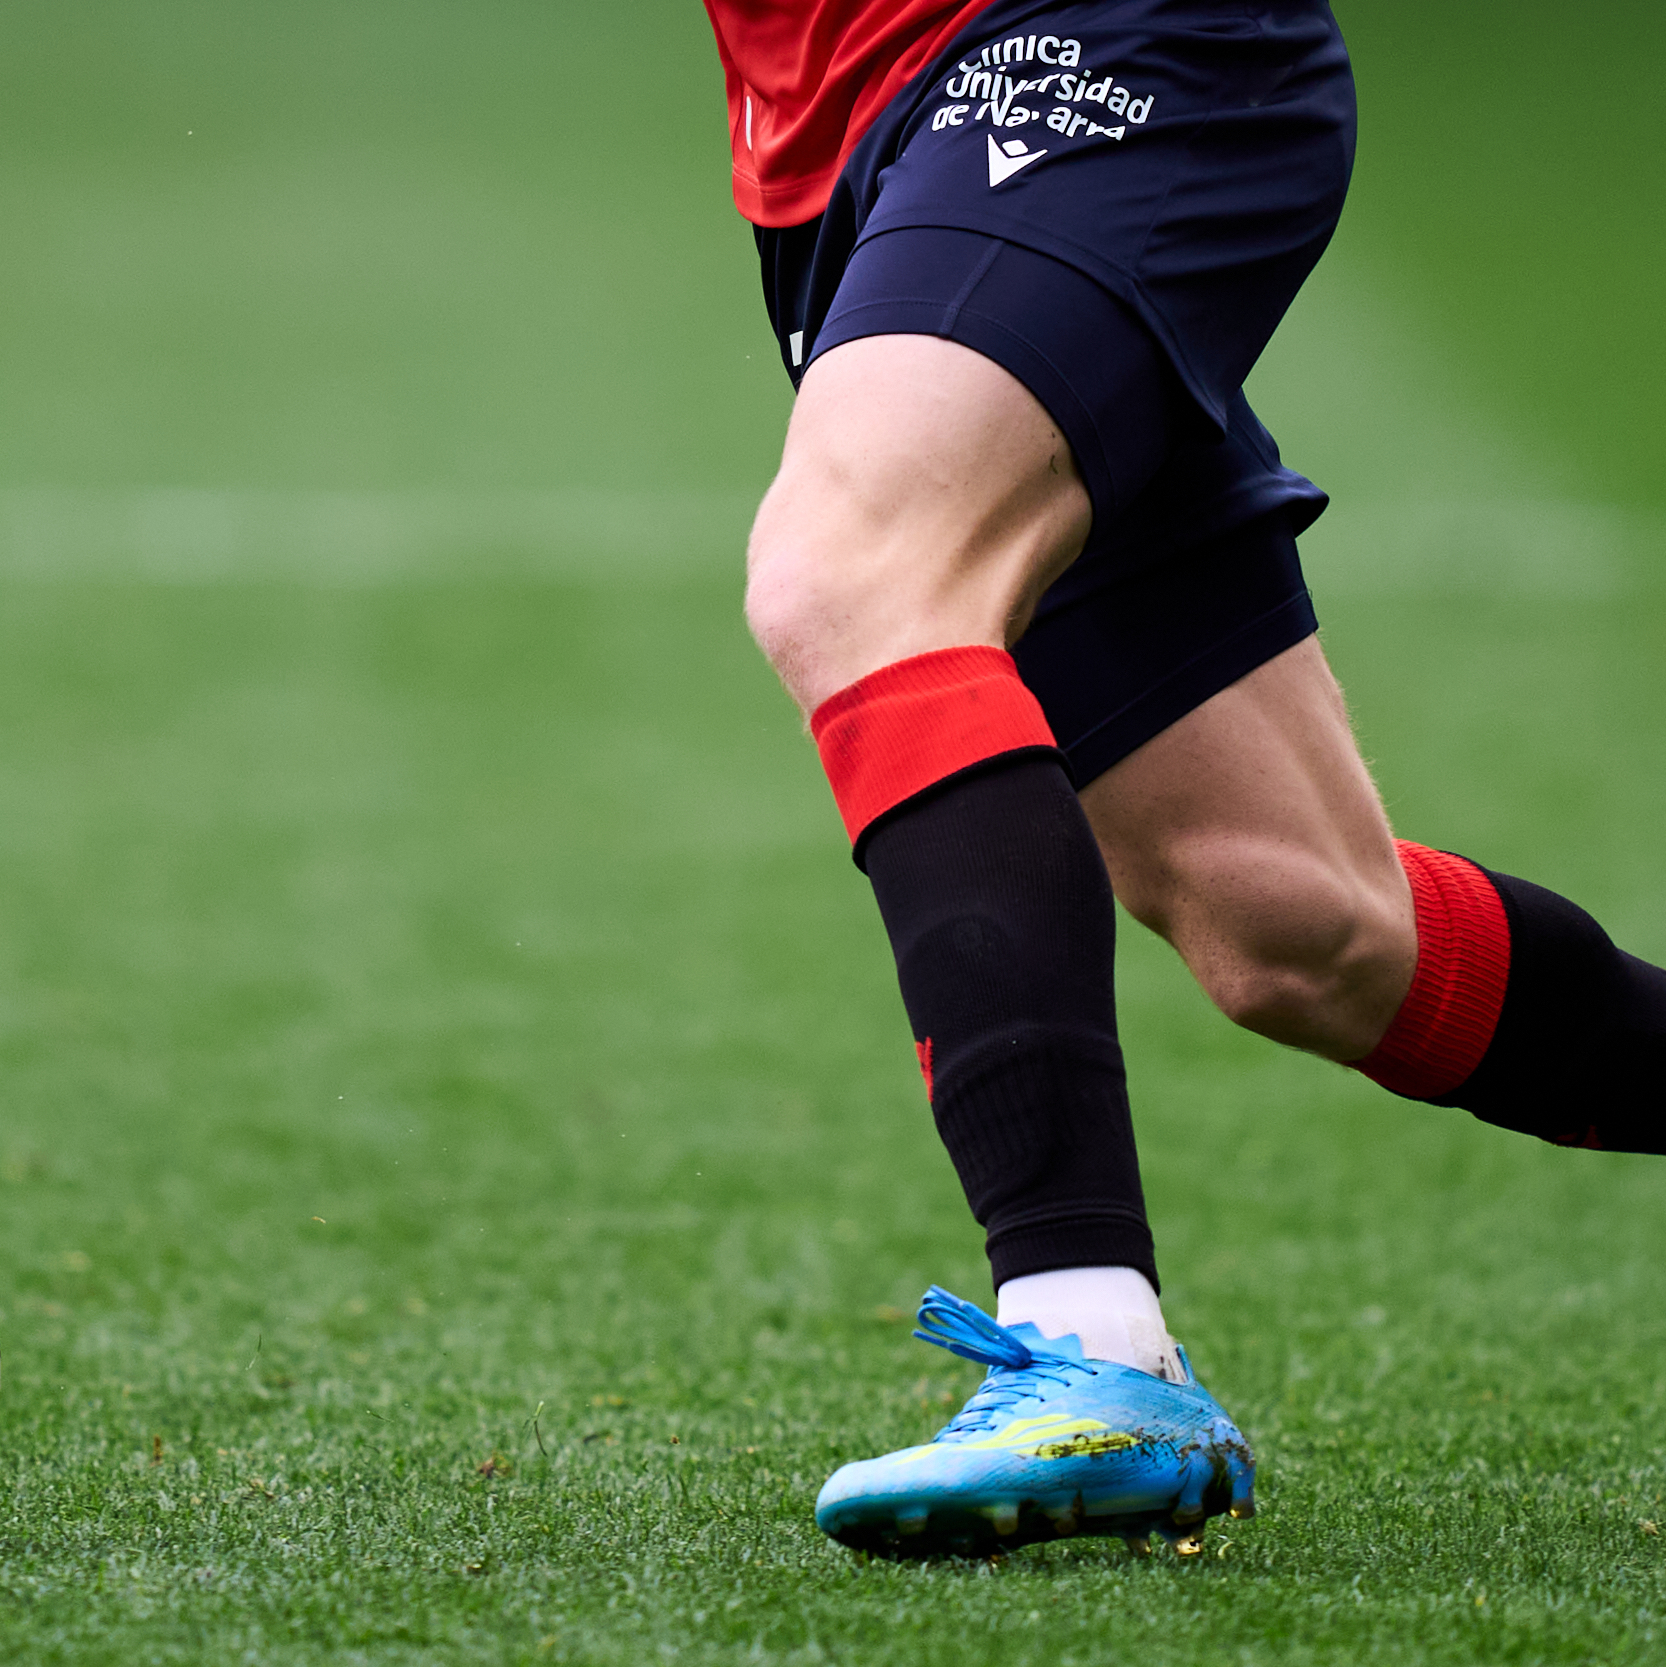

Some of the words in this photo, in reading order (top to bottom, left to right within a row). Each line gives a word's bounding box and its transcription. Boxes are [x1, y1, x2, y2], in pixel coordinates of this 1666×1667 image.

[931, 104, 970, 131] de
[974, 98, 1126, 141] Naarra
[946, 66, 1155, 124] Universidad
